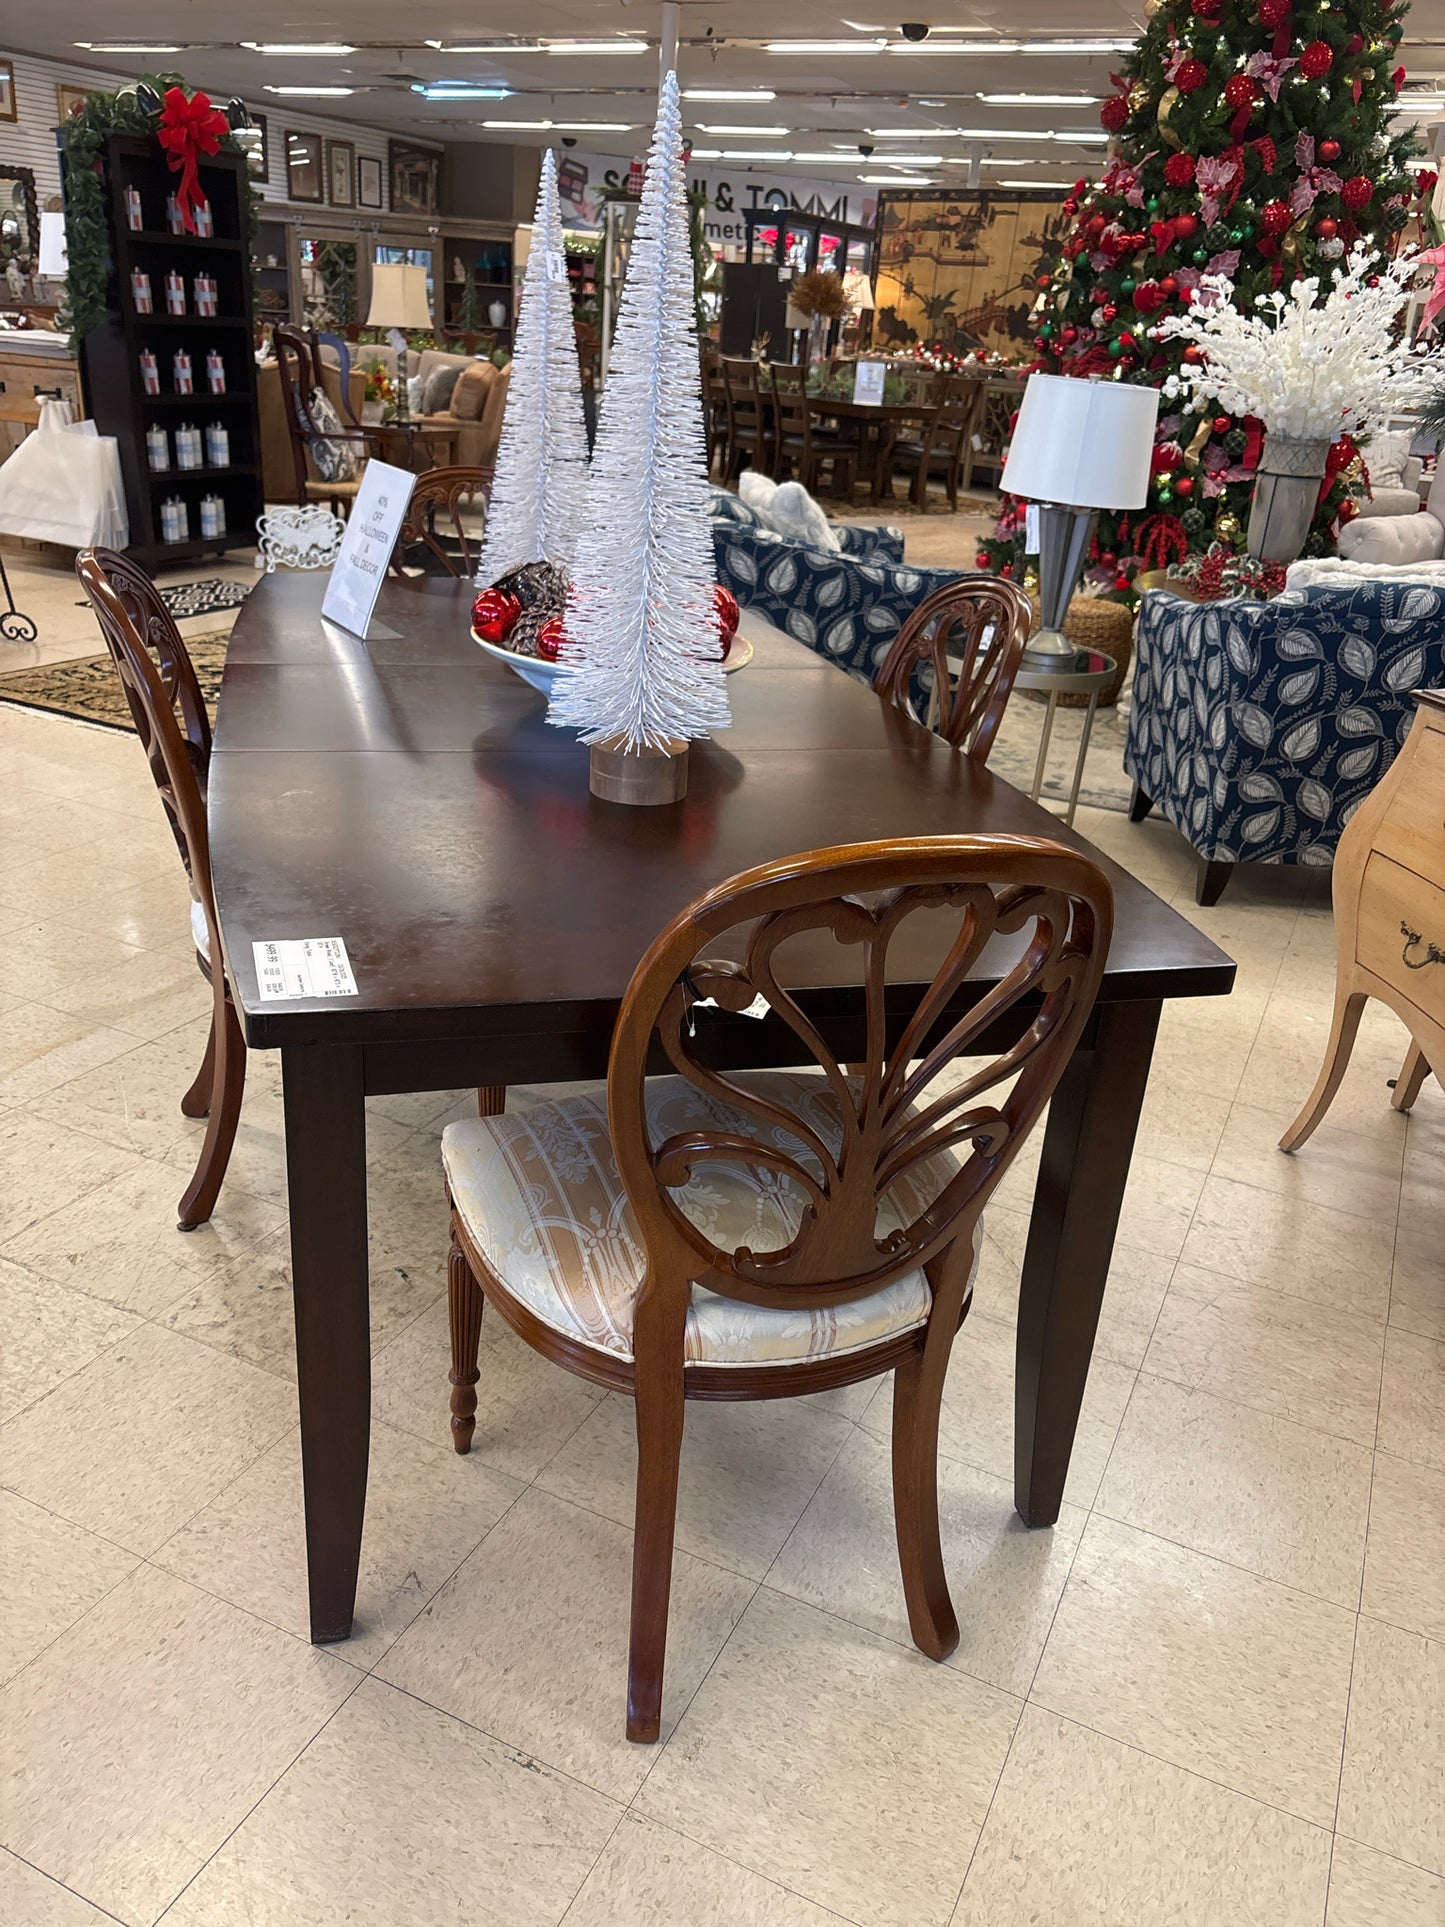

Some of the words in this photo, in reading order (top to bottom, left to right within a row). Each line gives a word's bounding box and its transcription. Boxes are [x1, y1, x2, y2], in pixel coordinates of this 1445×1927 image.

[715, 182, 735, 213] &
[746, 184, 848, 223] TOMMI
[373, 511, 384, 523] OFF
[360, 524, 389, 544] HALLOWEEN
[350, 554, 361, 568] FALL
[361, 559, 379, 576] DECOR
